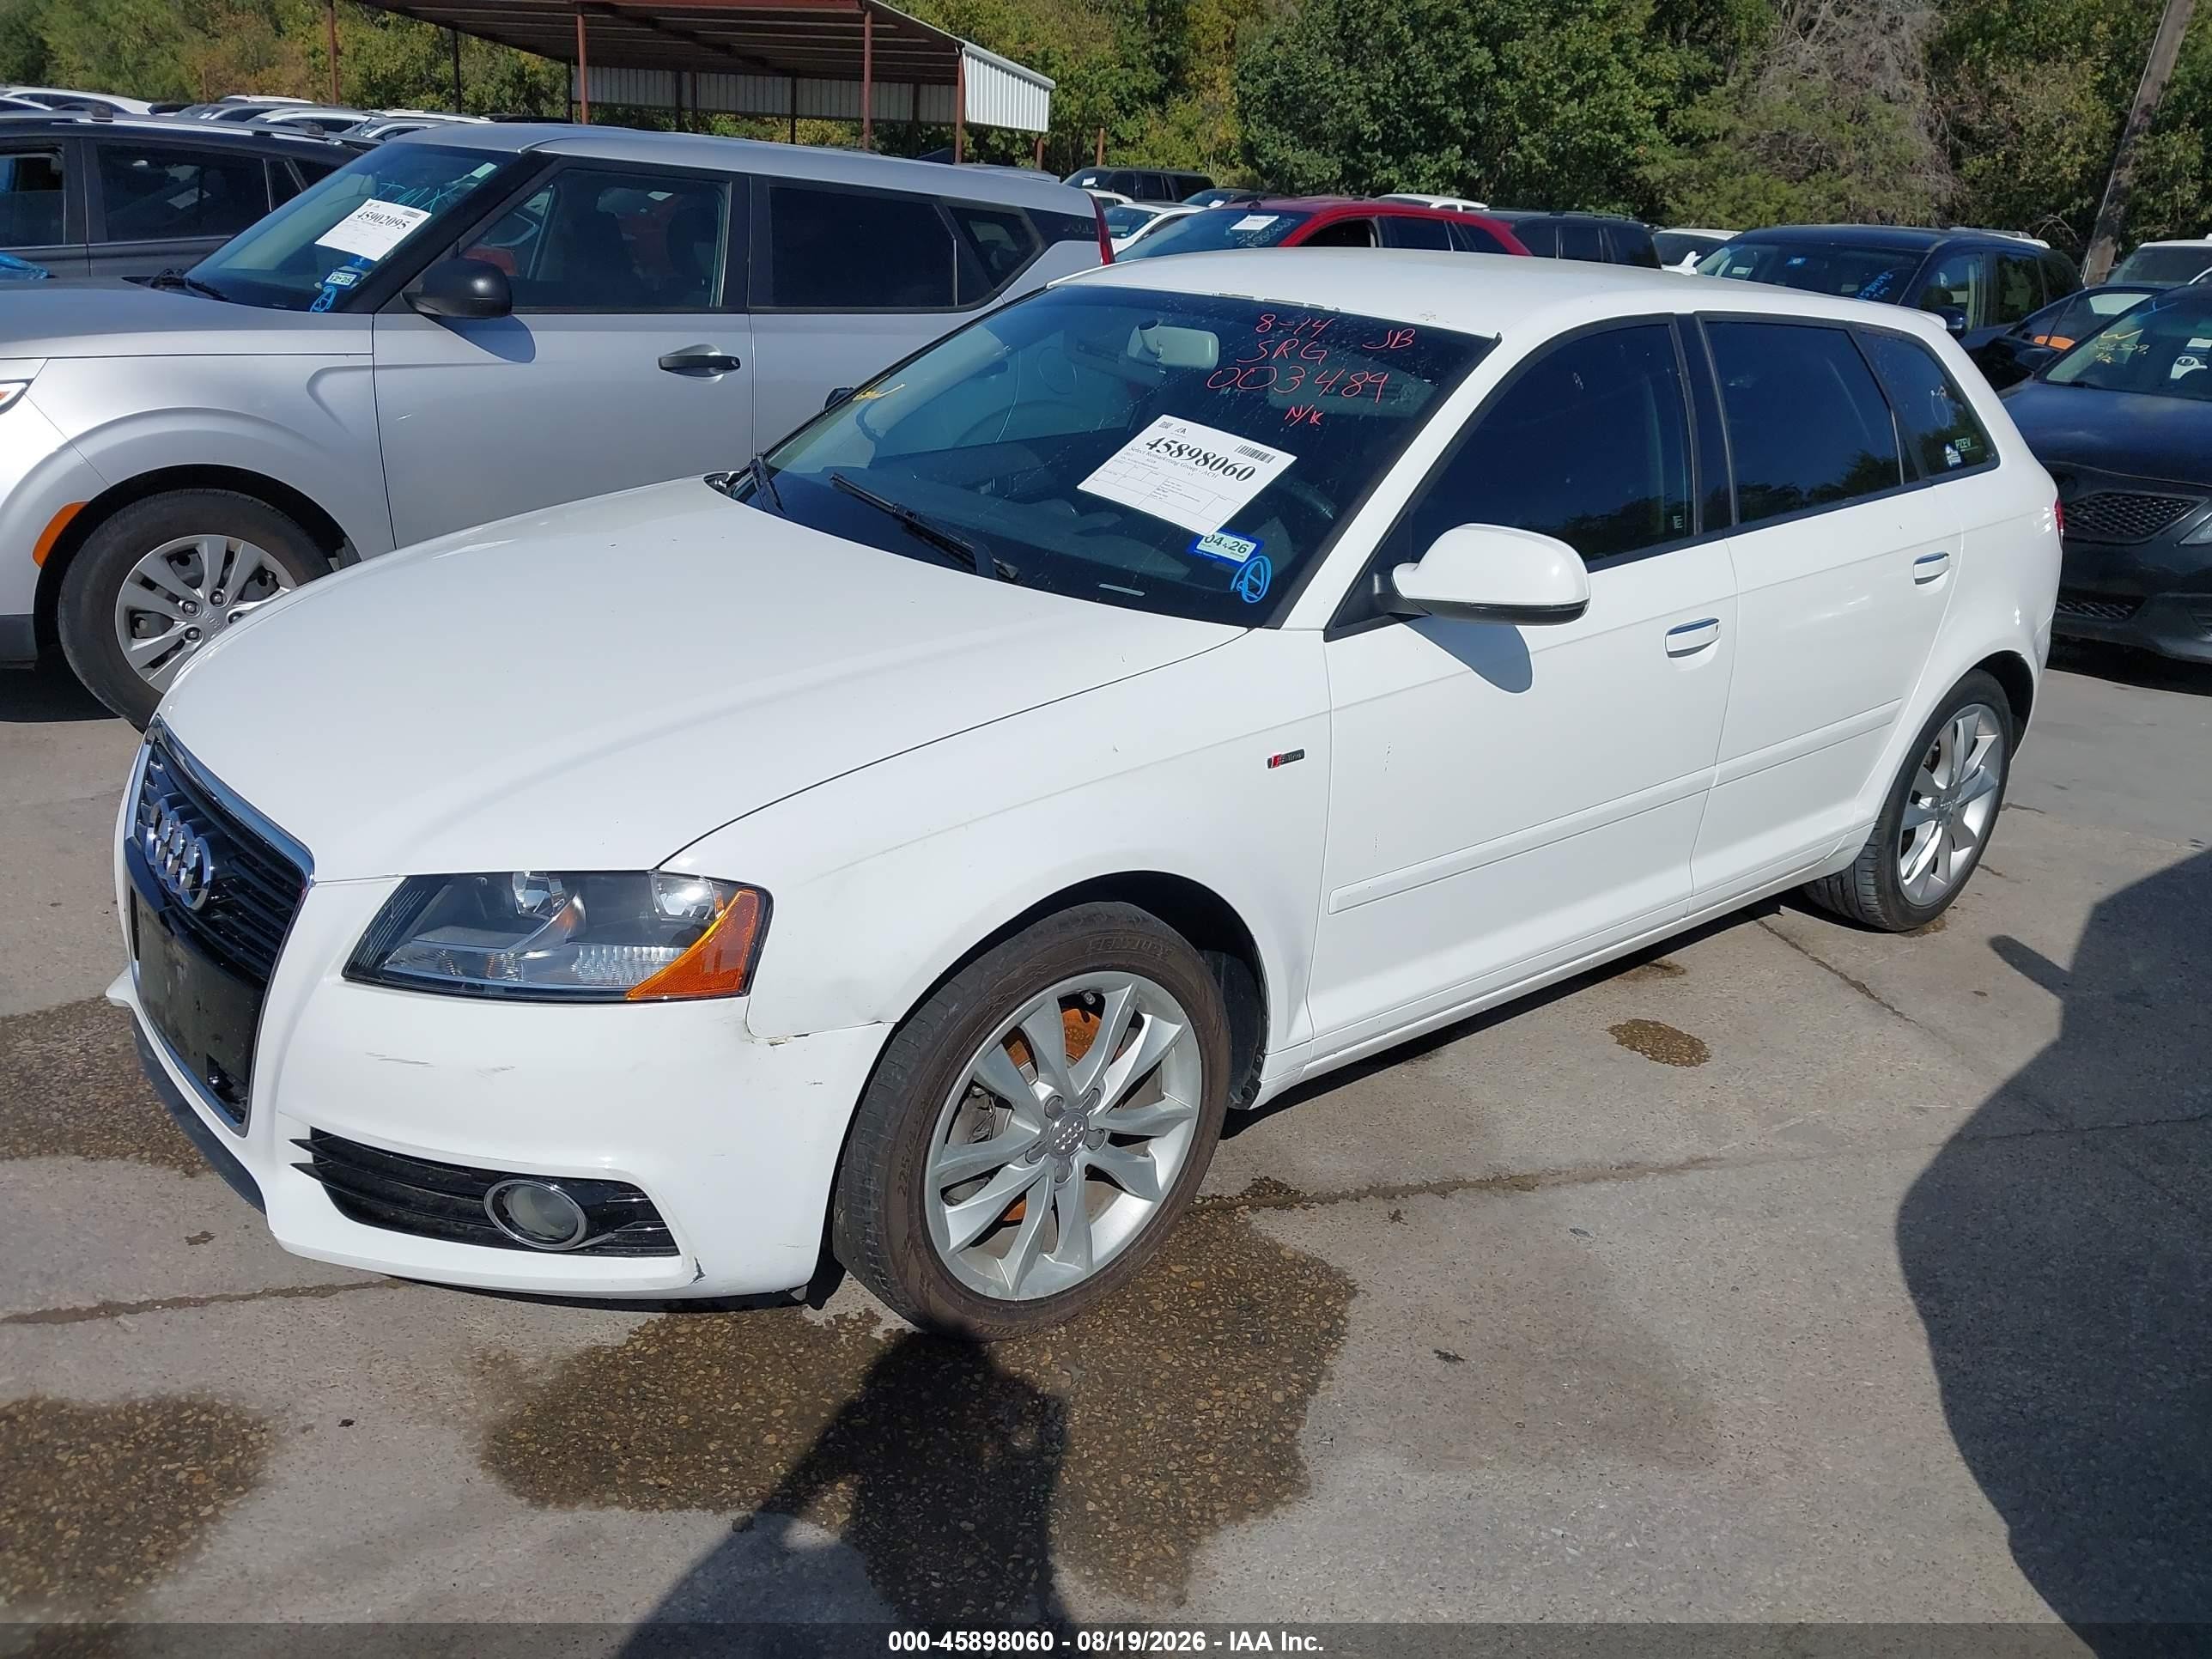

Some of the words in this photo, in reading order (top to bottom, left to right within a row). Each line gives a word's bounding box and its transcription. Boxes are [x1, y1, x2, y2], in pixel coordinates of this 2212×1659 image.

[356, 210, 411, 230] 45902095
[1255, 313, 1335, 338] 8-14
[1236, 338, 1328, 366] SRG
[1206, 366, 1389, 404] 003489
[1954, 437, 1972, 449] PZEV
[1145, 436, 1256, 482] 45898060
[1204, 534, 1224, 546] 04
[1228, 540, 1249, 554] 26
